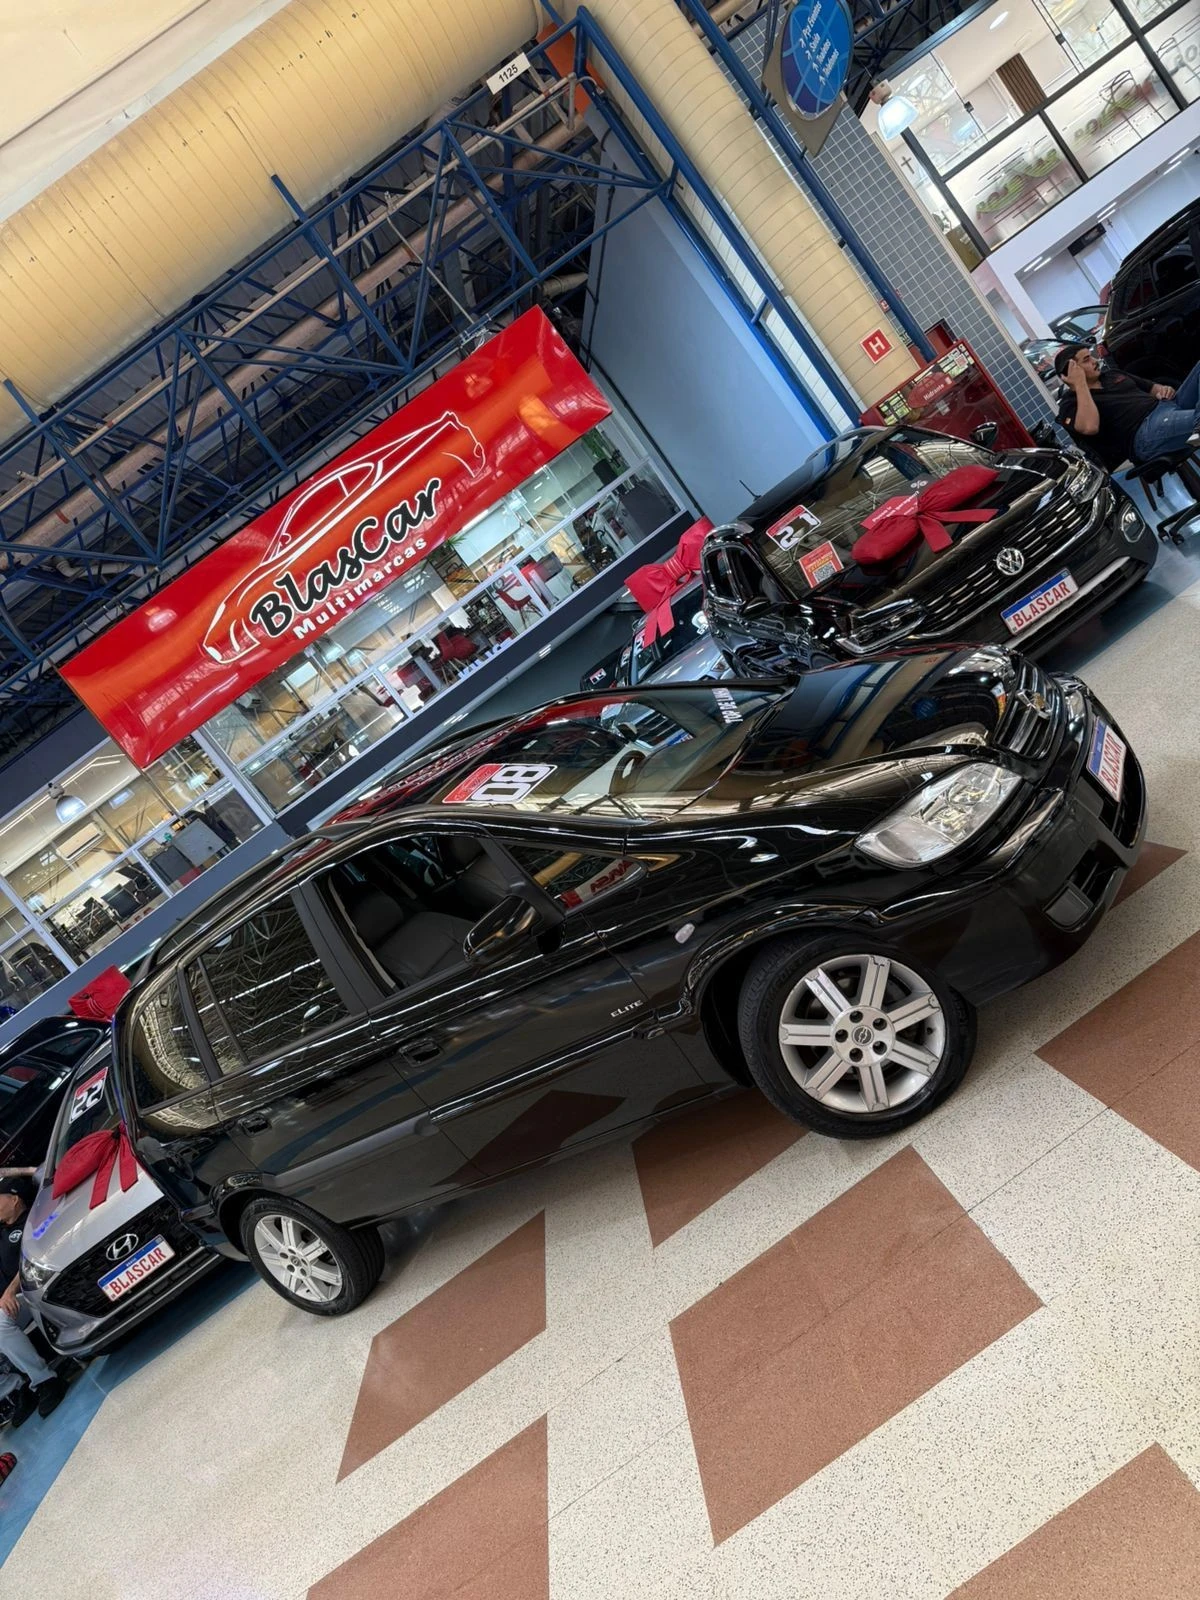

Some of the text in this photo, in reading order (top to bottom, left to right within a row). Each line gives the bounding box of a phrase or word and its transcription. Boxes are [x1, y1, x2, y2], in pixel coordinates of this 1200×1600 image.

[499, 64, 518, 83] 1125
[868, 336, 886, 356] H
[923, 383, 945, 401] Hidrante
[775, 512, 819, 549] 21
[250, 477, 441, 638] BlasCar
[292, 537, 428, 640] Multimarcas
[1012, 581, 1071, 628] BLASCAR
[1100, 732, 1123, 791] BLASCAR
[470, 766, 551, 802] 08
[610, 1000, 644, 1018] ELITE
[71, 1079, 106, 1120] 22
[109, 1247, 167, 1296] BLASCAR
